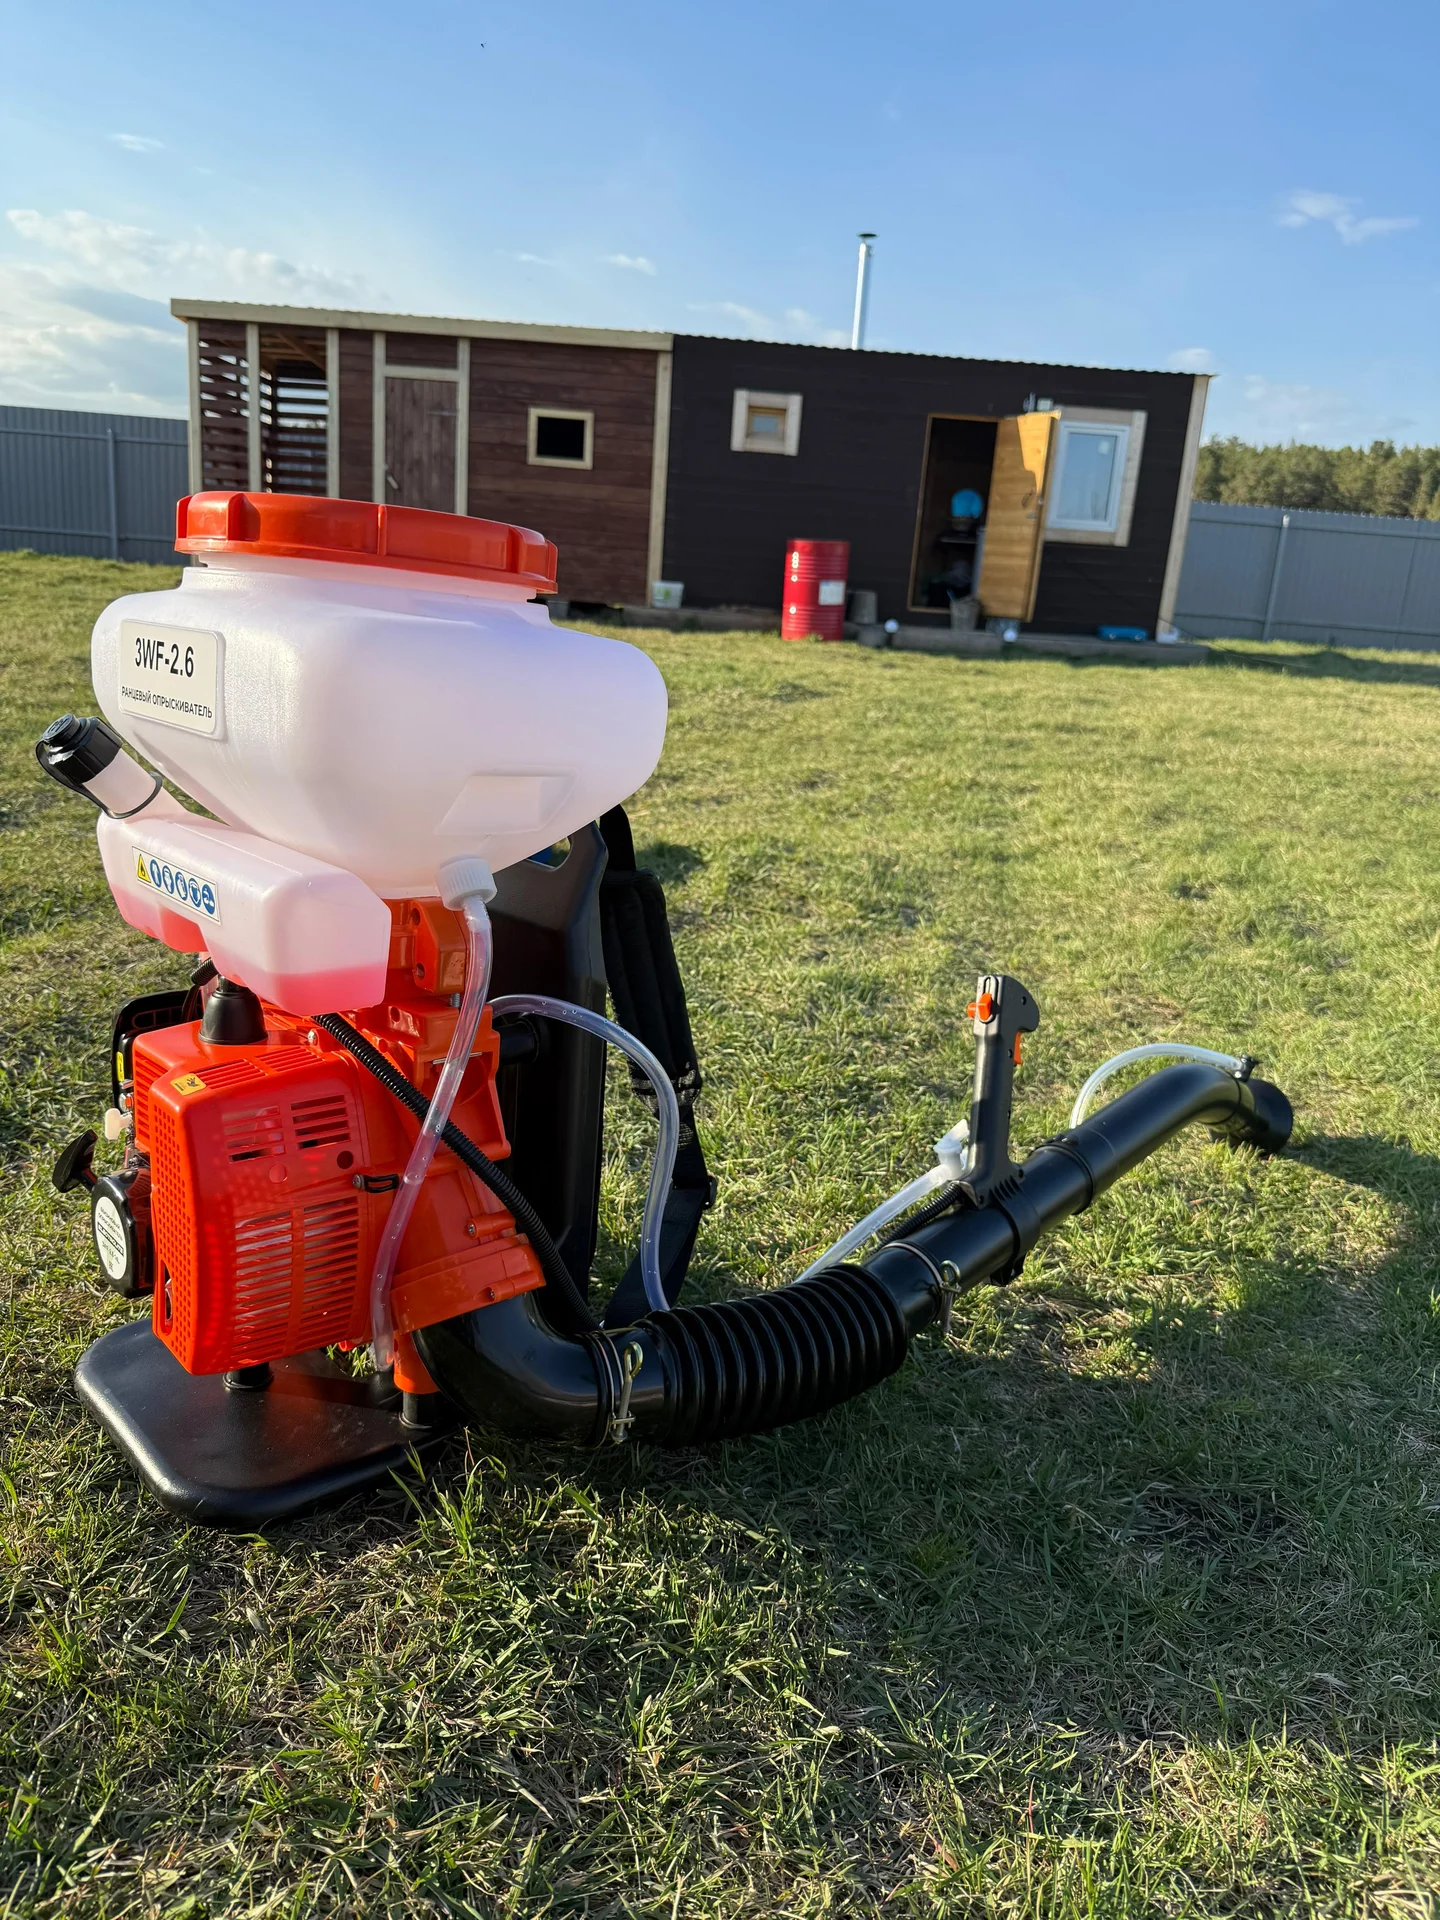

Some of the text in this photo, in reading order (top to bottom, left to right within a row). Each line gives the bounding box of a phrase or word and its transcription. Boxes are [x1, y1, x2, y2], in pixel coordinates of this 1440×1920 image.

[135, 637, 194, 677] 3WF-2.6
[121, 686, 213, 718] РАНЦЕВЫЙ ОПРЫСКИВАТЕЛЬ
